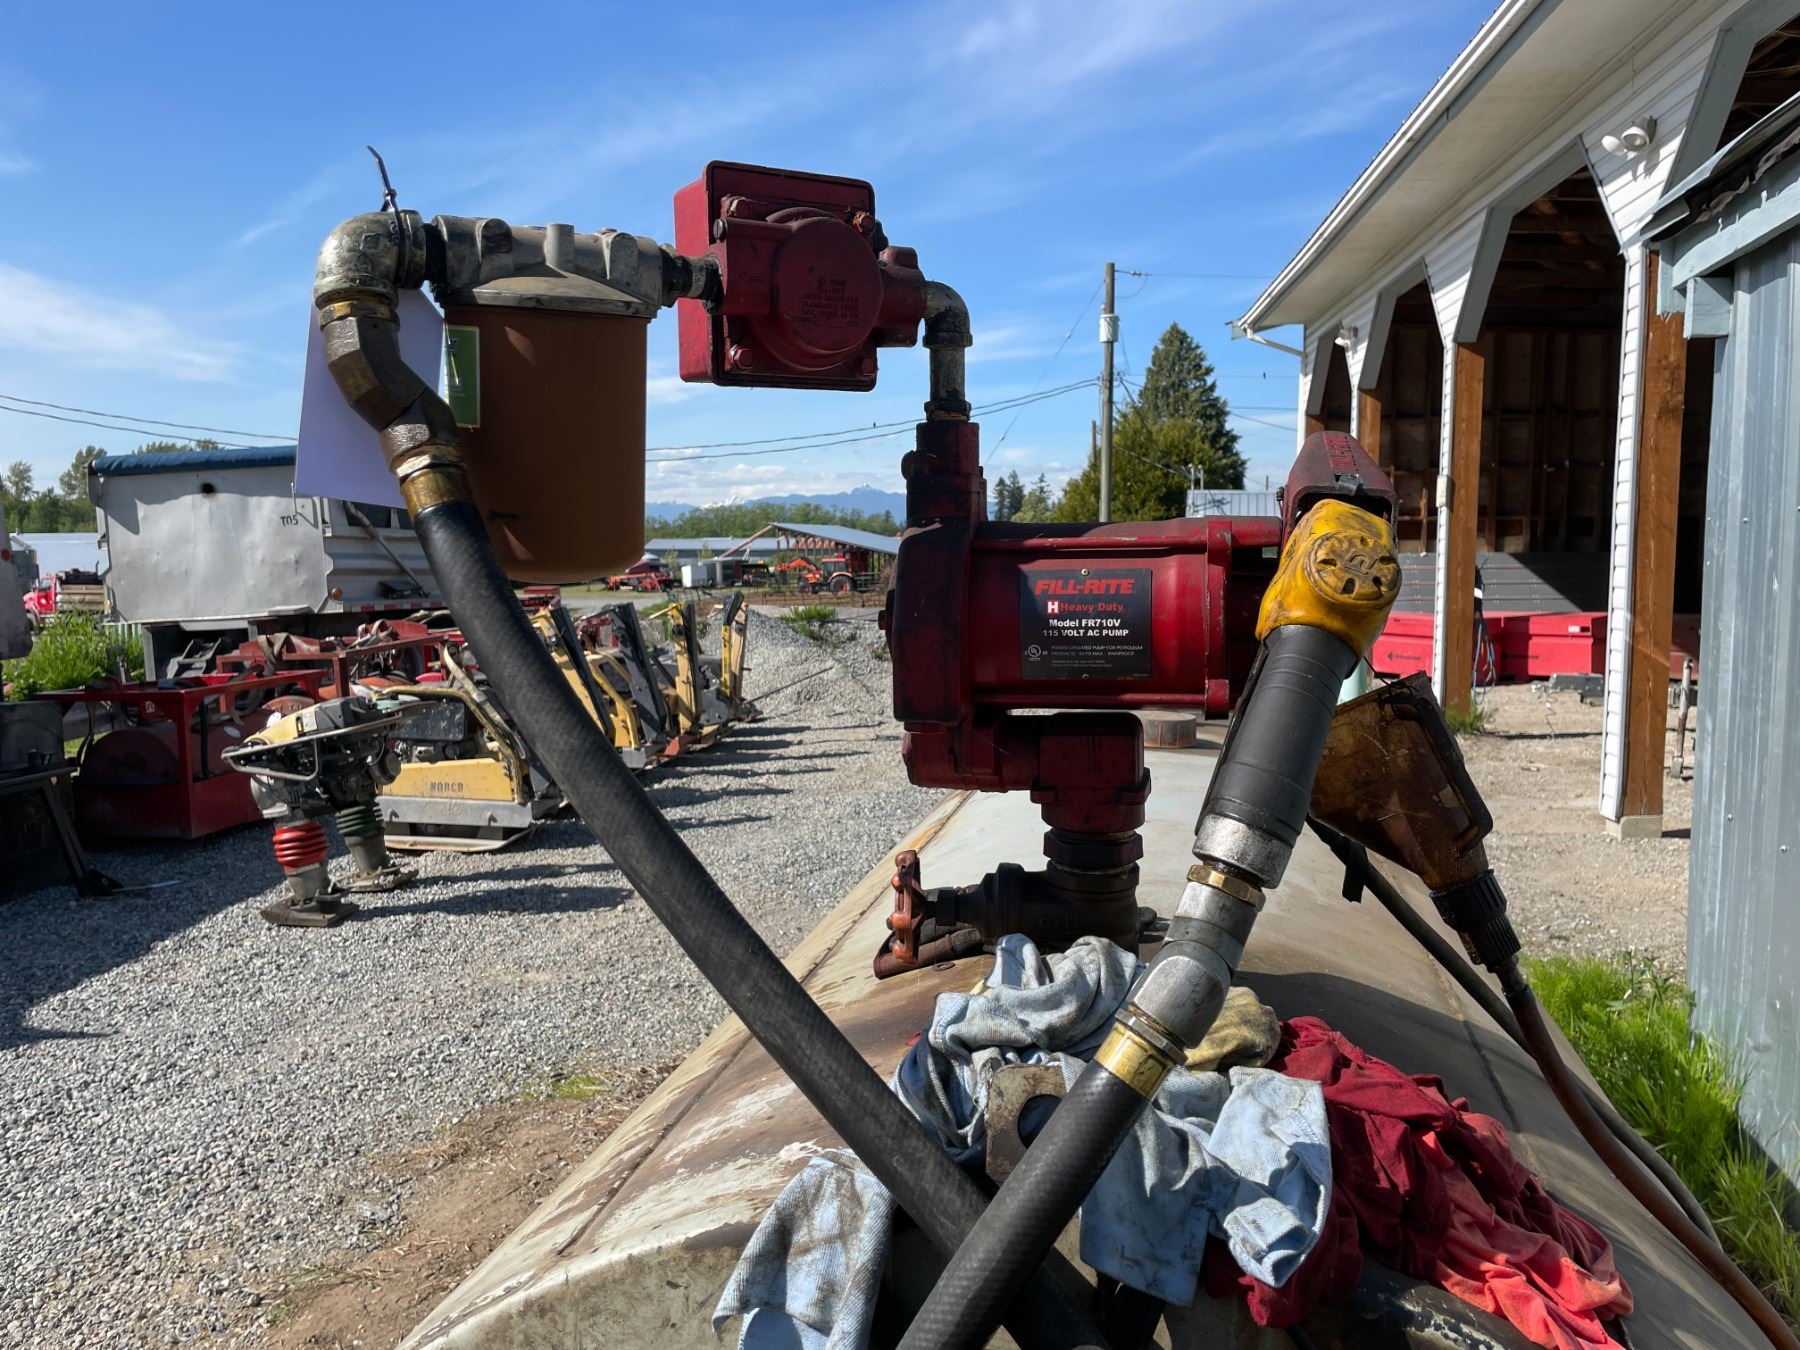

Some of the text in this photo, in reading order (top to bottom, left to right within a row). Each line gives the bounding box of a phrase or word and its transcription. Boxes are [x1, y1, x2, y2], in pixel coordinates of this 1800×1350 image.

[1034, 578, 1136, 595] FILL-RITE
[1060, 602, 1095, 613] Heavy
[1098, 602, 1124, 613] Duty
[1049, 618, 1121, 627] Model FR710V
[1043, 629, 1129, 637] 115 VOLT AC PUMP
